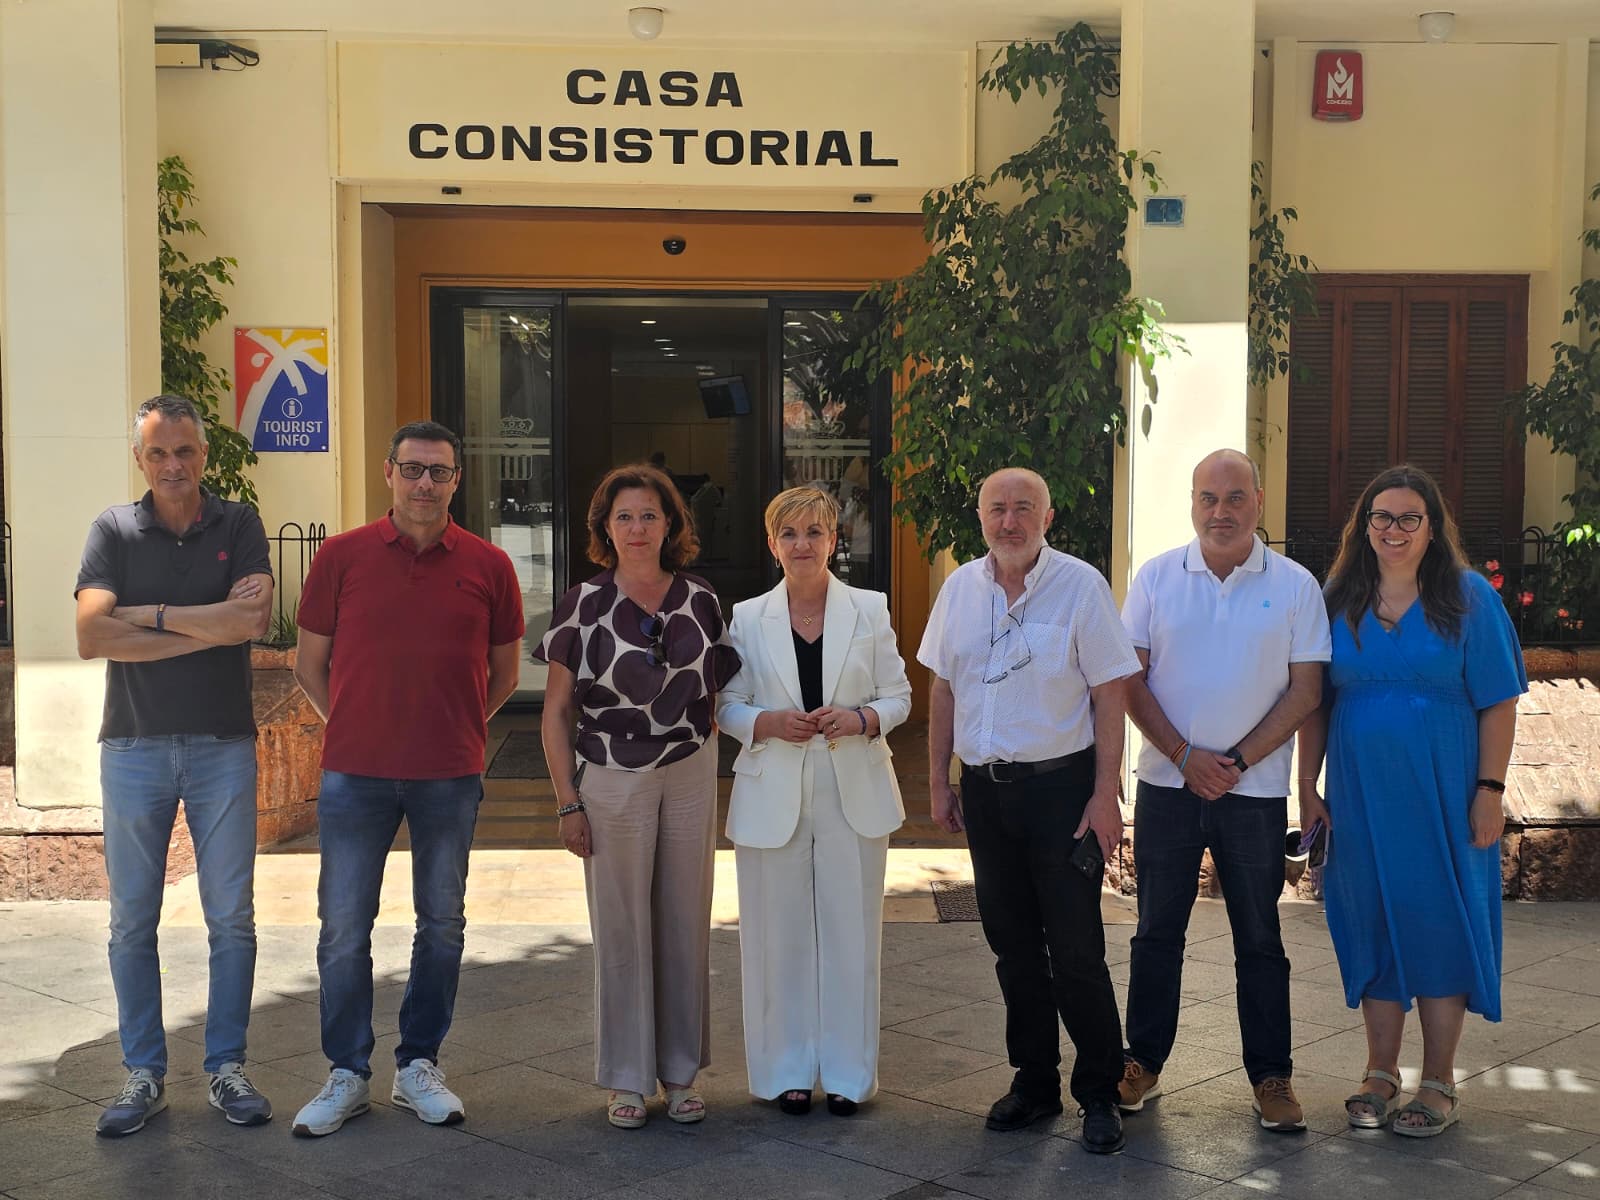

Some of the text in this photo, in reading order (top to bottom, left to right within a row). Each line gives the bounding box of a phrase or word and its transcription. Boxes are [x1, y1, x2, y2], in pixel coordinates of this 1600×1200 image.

[567, 69, 743, 107] CASA
[408, 123, 899, 166] CONSISTORIAL
[263, 421, 323, 433] TOURIST
[276, 434, 310, 446] INFO
